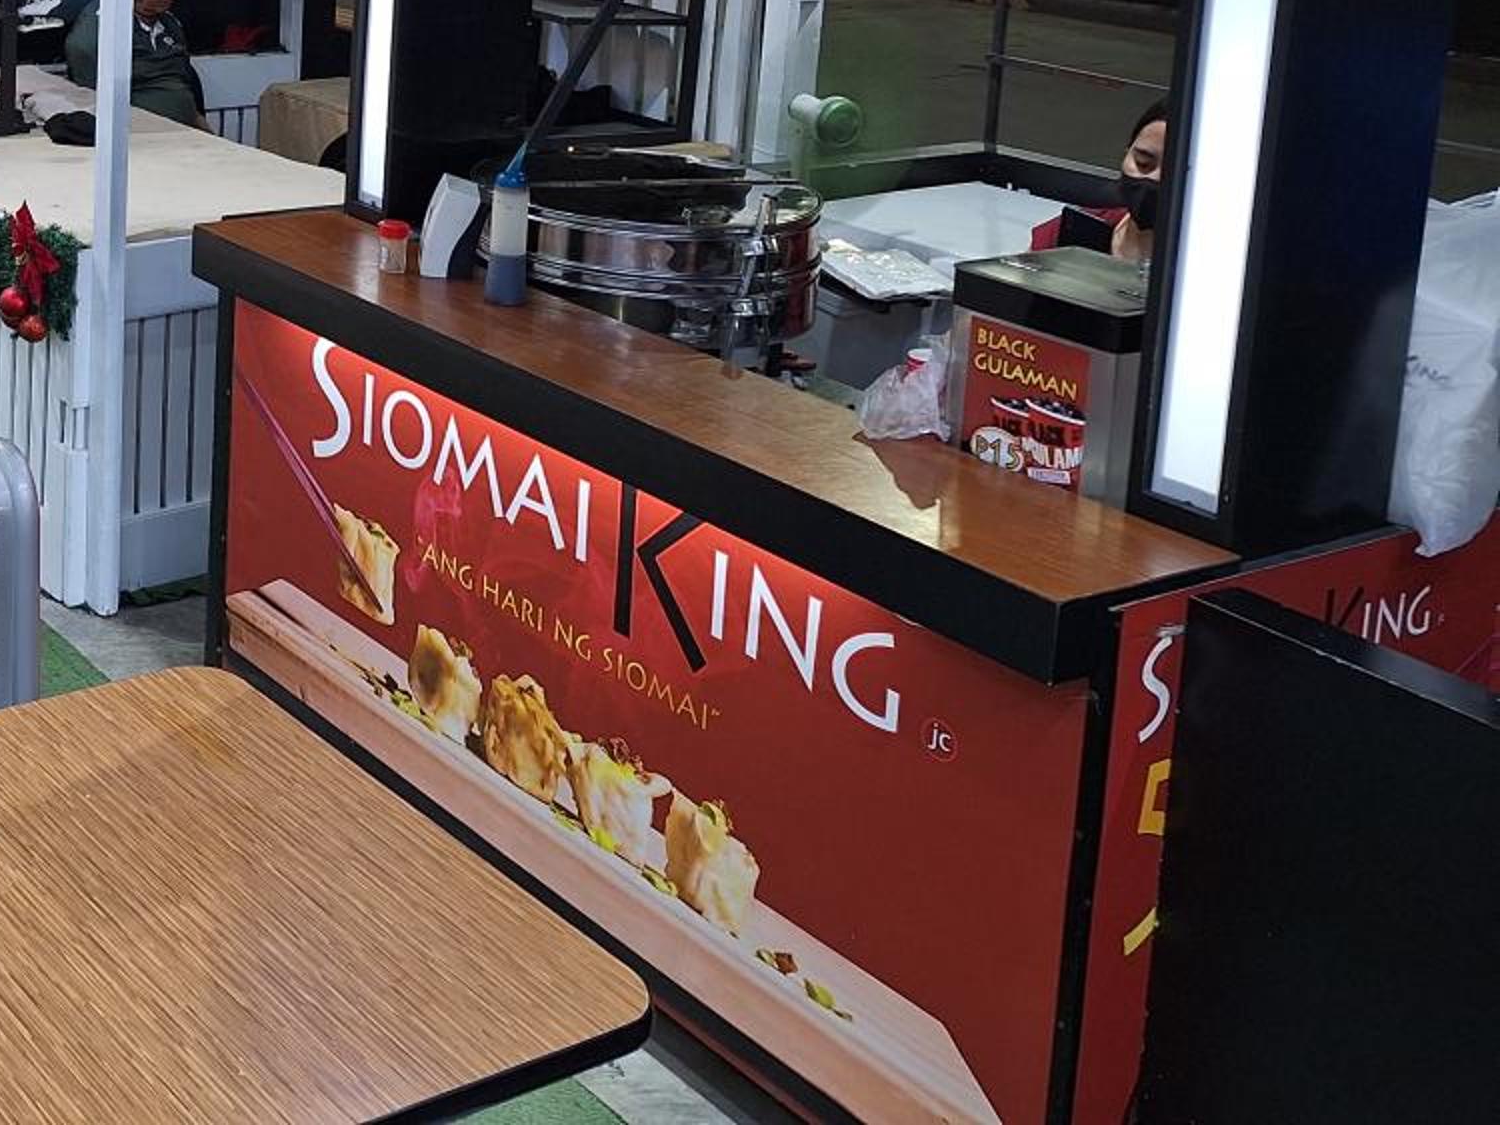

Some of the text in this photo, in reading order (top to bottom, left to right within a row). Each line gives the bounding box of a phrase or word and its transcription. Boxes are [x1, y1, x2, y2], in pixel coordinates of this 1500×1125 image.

[974, 353, 1078, 401] GULAMAN
[977, 327, 1037, 362] BLACK
[312, 337, 592, 563] SIOMAI
[613, 480, 900, 733] KING
[483, 574, 544, 633] HARI
[553, 618, 592, 661] NG
